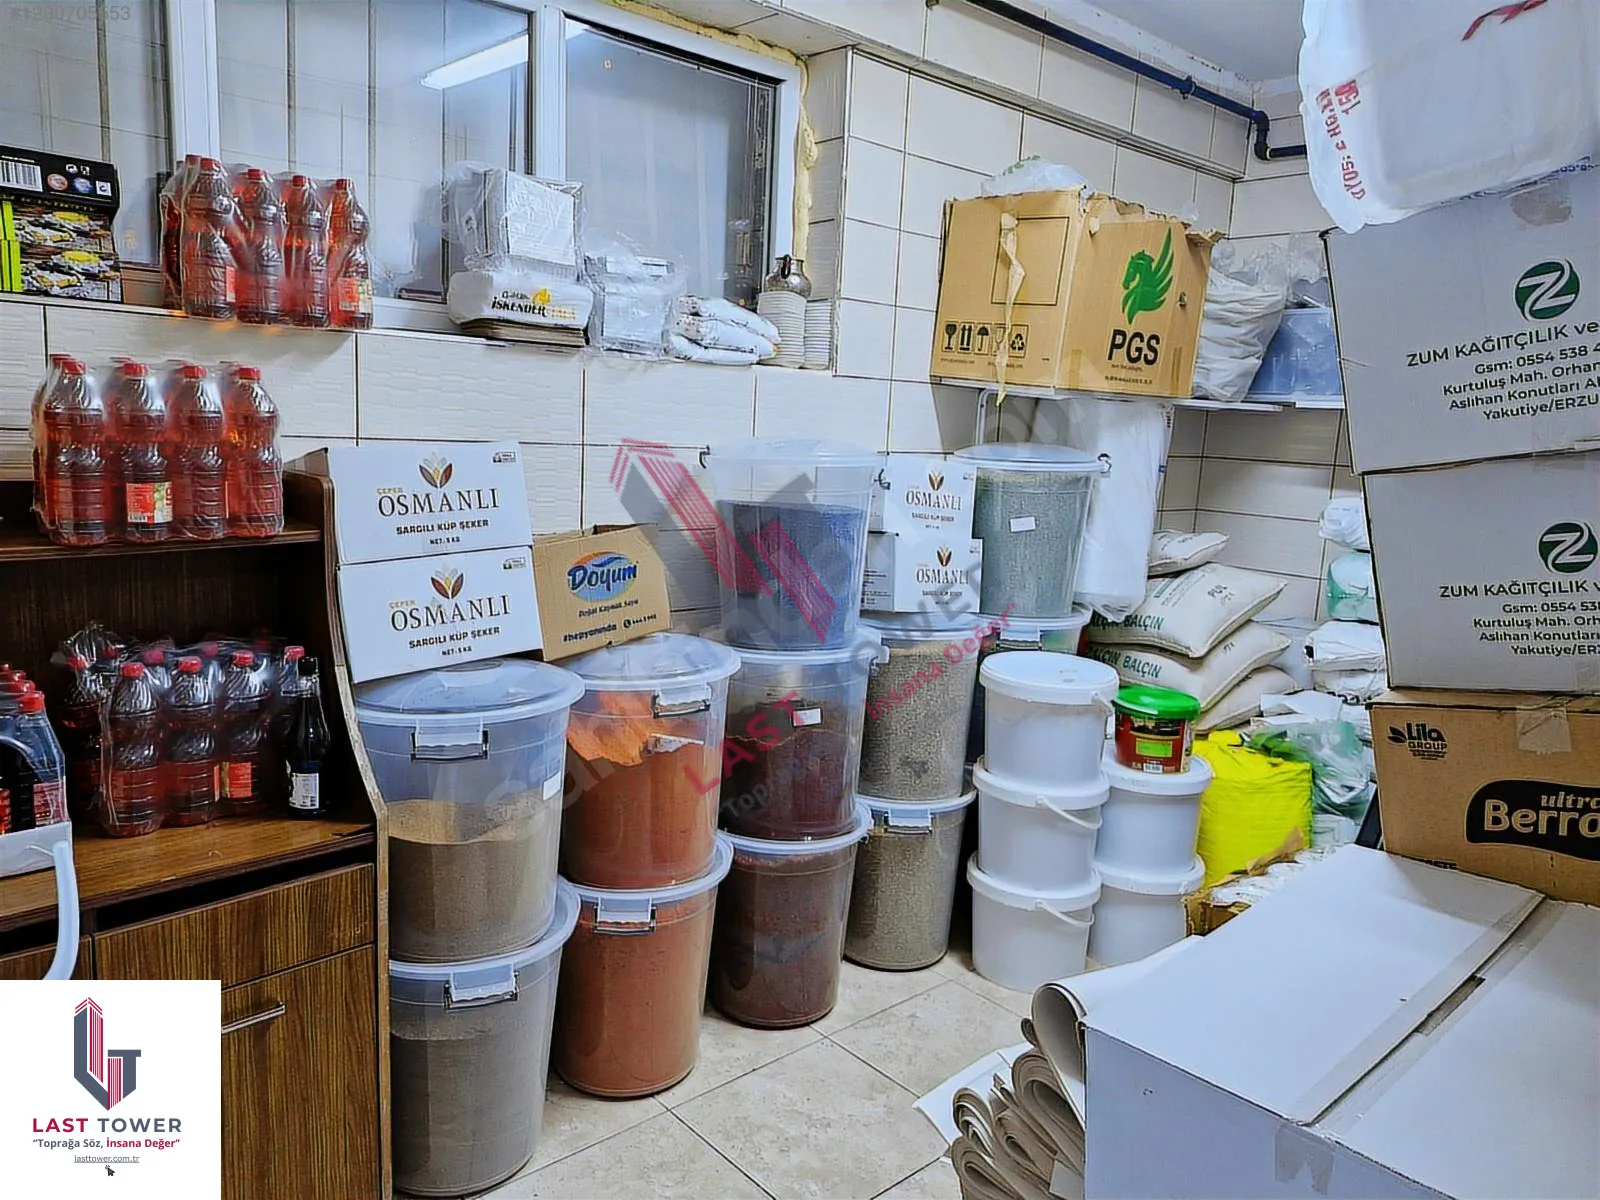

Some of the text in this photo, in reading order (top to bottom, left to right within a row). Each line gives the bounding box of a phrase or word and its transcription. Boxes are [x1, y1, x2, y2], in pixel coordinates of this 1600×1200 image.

[1107, 329, 1161, 366] PGS
[1406, 321, 1600, 367] ZUM KAĞITÇILIK ve
[1474, 360, 1513, 375] Gsm:
[1516, 352, 1556, 368] 0554
[1559, 345, 1588, 361] 538
[1443, 375, 1506, 396] Kurtuluş
[1510, 369, 1548, 385] Mah.
[1449, 393, 1503, 410] Aslıhan
[1507, 382, 1580, 401] Konutları
[1483, 393, 1599, 421] Yakutiye/ERZU
[378, 487, 500, 517] OSMANLI
[905, 490, 961, 511] OSMANLI
[396, 519, 489, 535] SARGILI KÜP ŞEKER
[567, 563, 637, 592] Doyum
[916, 568, 969, 585] OSMANLI
[1439, 585, 1478, 598] ZUM
[1484, 580, 1589, 598] KAĞITÇILIK
[391, 594, 511, 632] OSMANLI
[1502, 603, 1538, 614] Gsm:
[1541, 602, 1577, 612] 0554
[1123, 614, 1164, 631] BALÇIN
[1473, 616, 1532, 629] Kurtuluş
[1535, 617, 1571, 627] Mah.
[408, 626, 500, 649] SARGILI KÜP ŞEKER
[1479, 631, 1530, 642] Aslıhan
[1123, 655, 1162, 678] BALÇIN
[1405, 722, 1447, 742] Lila
[1408, 741, 1448, 751] GROUP
